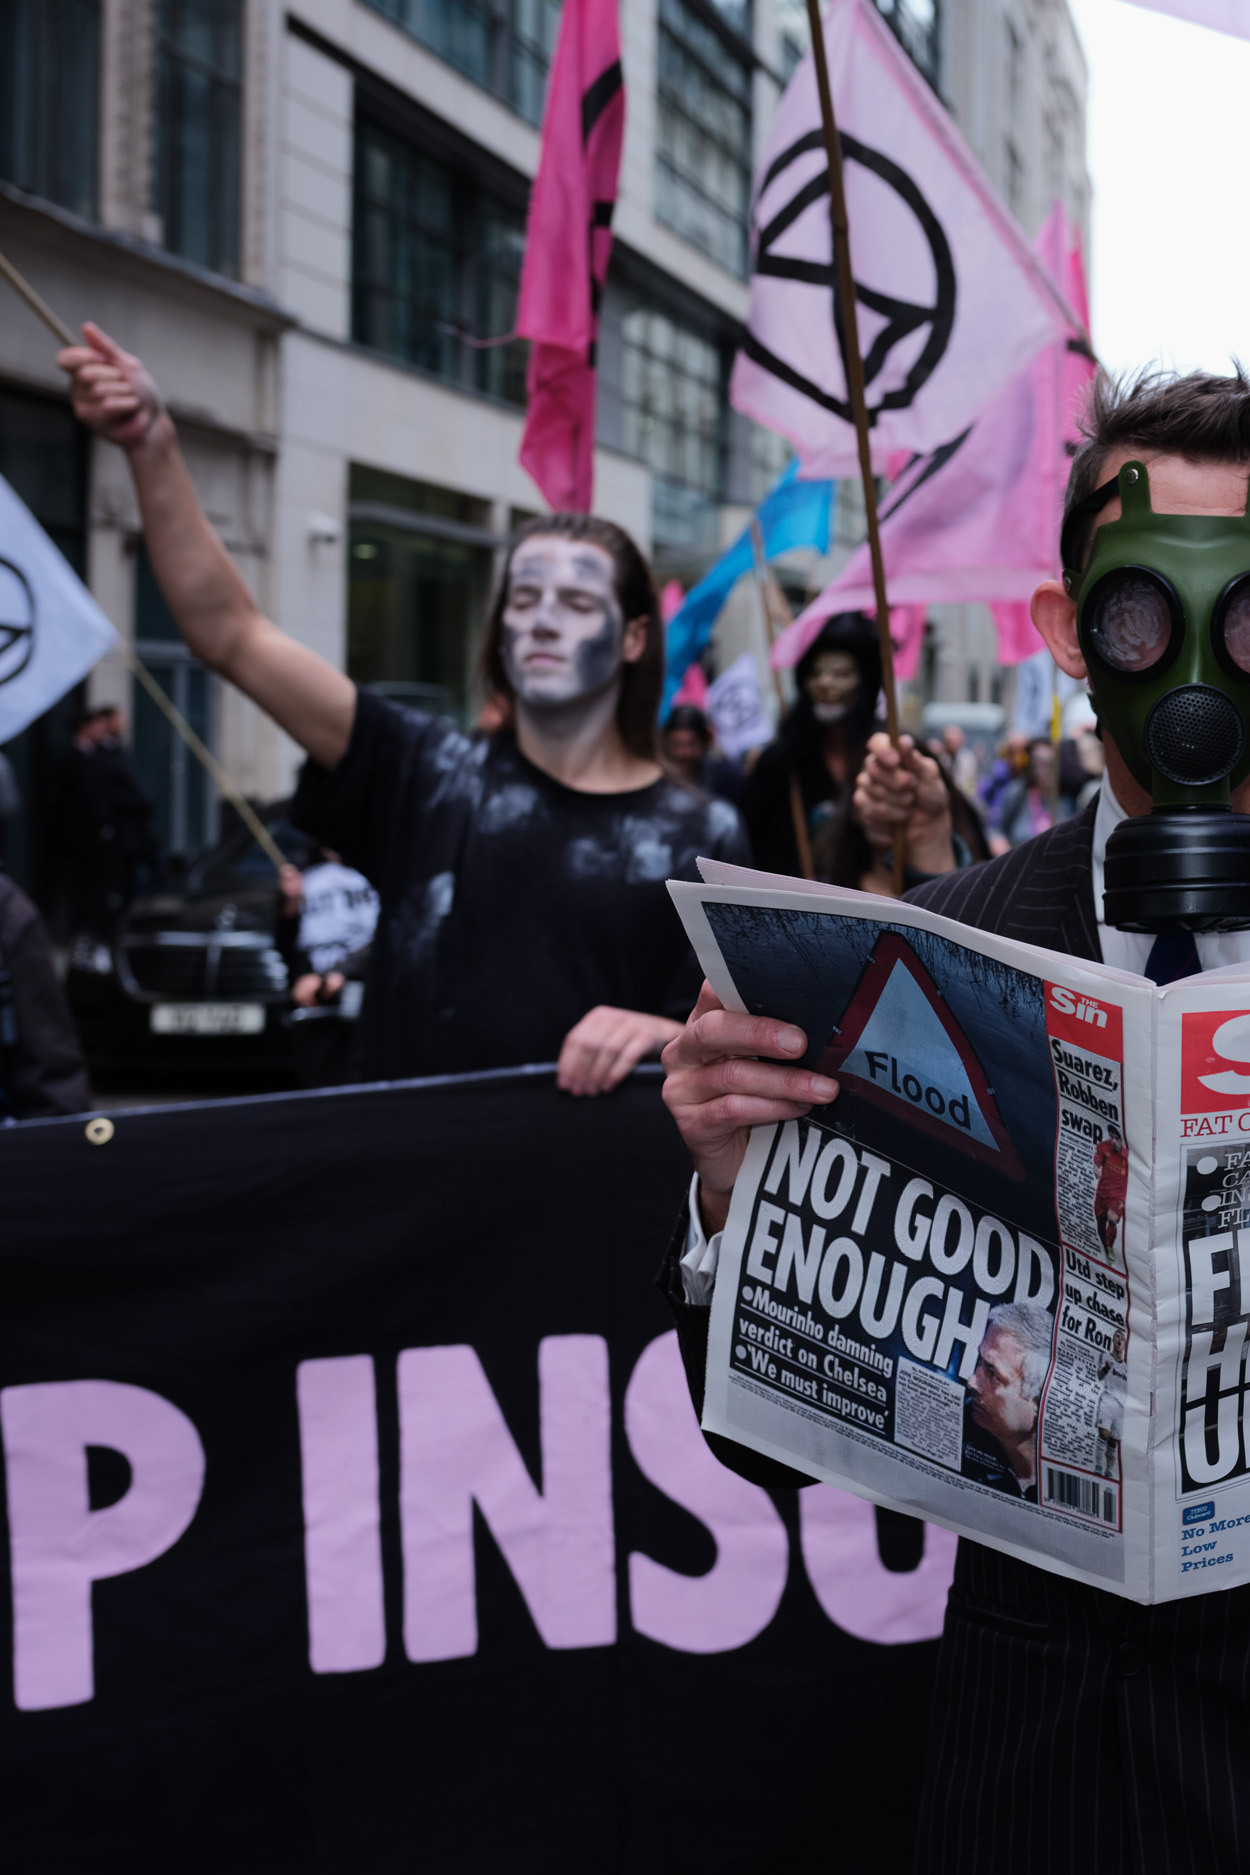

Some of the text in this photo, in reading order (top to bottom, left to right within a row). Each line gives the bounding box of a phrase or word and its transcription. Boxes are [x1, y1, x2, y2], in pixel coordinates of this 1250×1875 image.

[1050, 987, 1108, 1029] Sin
[1081, 997, 1099, 1009] THE
[1052, 1039, 1119, 1091] Suarez,
[864, 1051, 972, 1131] Flood
[1057, 1069, 1119, 1121] Robben
[1062, 1108, 1103, 1145] swap
[1180, 1114, 1233, 1138] FAT
[765, 1119, 892, 1234] NOT
[894, 1177, 1056, 1311] GOOD
[746, 1200, 992, 1380] ENOUGH
[1066, 1249, 1126, 1299] Utd step
[1065, 1283, 1125, 1327] up chase
[752, 1285, 893, 1379] Mourinho damning
[1062, 1305, 1082, 1330] for
[1086, 1317, 1112, 1351] Ron
[739, 1317, 793, 1358] verdict
[798, 1348, 818, 1370] on
[823, 1354, 887, 1402] Chelsea
[781, 1368, 818, 1400] must
[1181, 1528, 1205, 1540] No
[1181, 1541, 1217, 1557] Low
[1181, 1552, 1234, 1573] Prices
